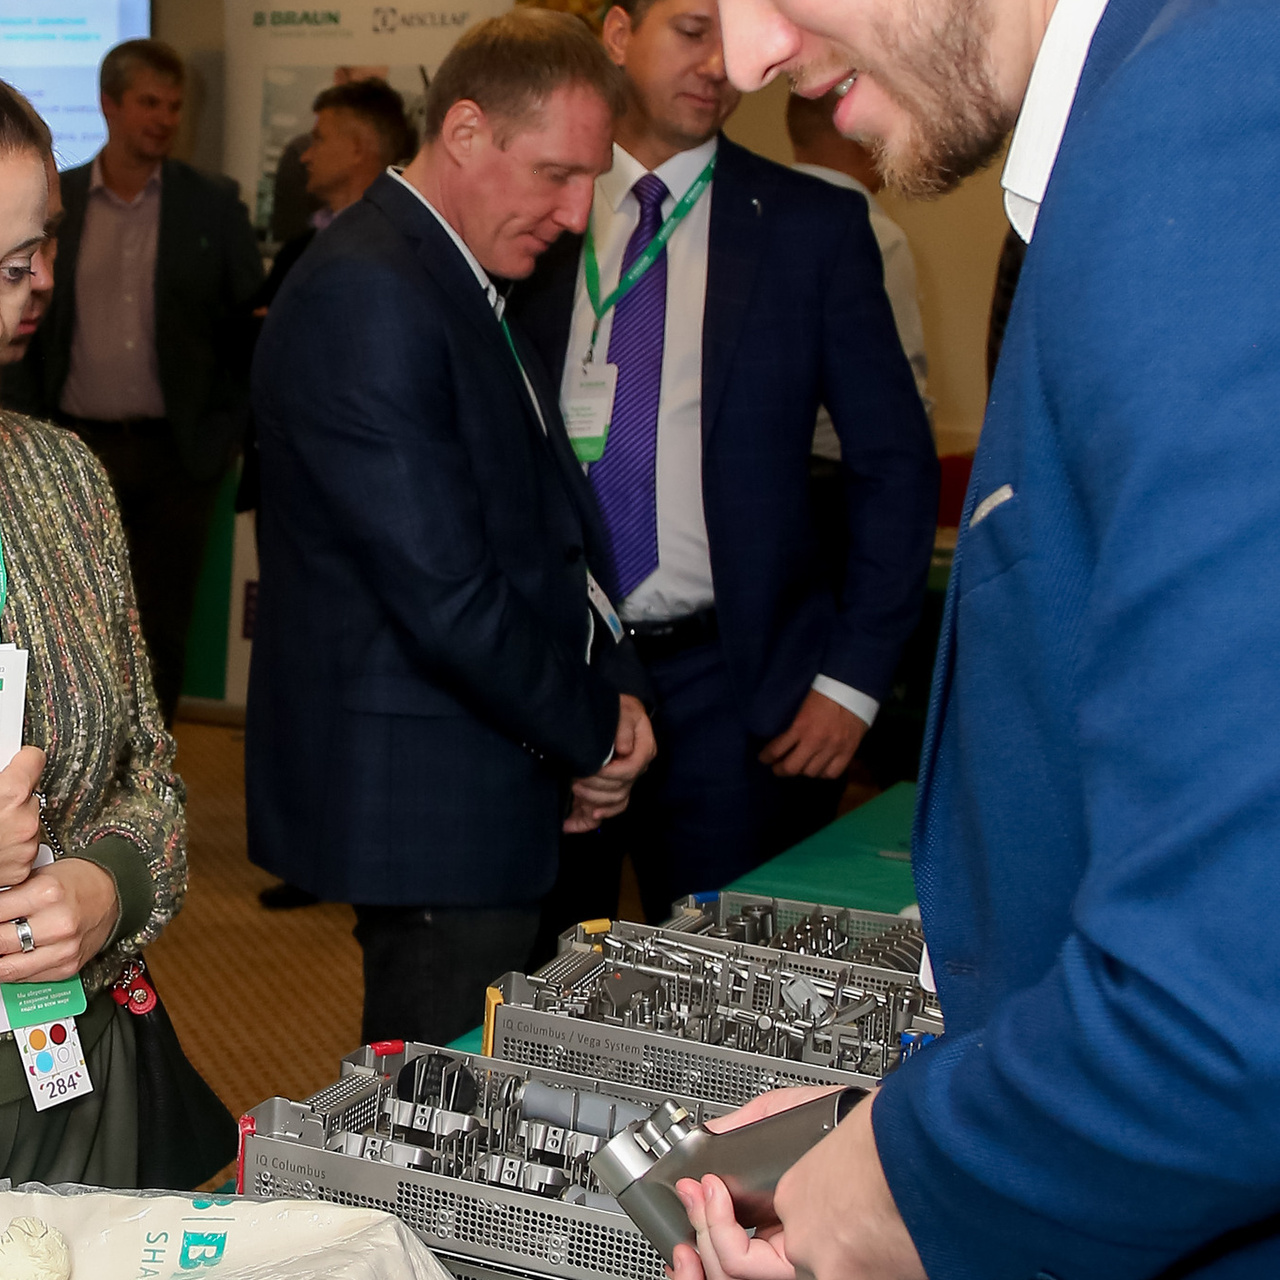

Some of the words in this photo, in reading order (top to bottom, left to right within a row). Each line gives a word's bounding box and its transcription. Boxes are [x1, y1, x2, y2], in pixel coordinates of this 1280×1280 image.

[270, 10, 341, 25] BRAUN
[502, 1018, 514, 1030] IQ
[516, 1021, 566, 1041] Columbus
[577, 1033, 602, 1049] Vega
[604, 1036, 641, 1056] System
[46, 1073, 78, 1099] 284
[255, 1153, 268, 1168] IQ
[270, 1155, 326, 1180] Columbus
